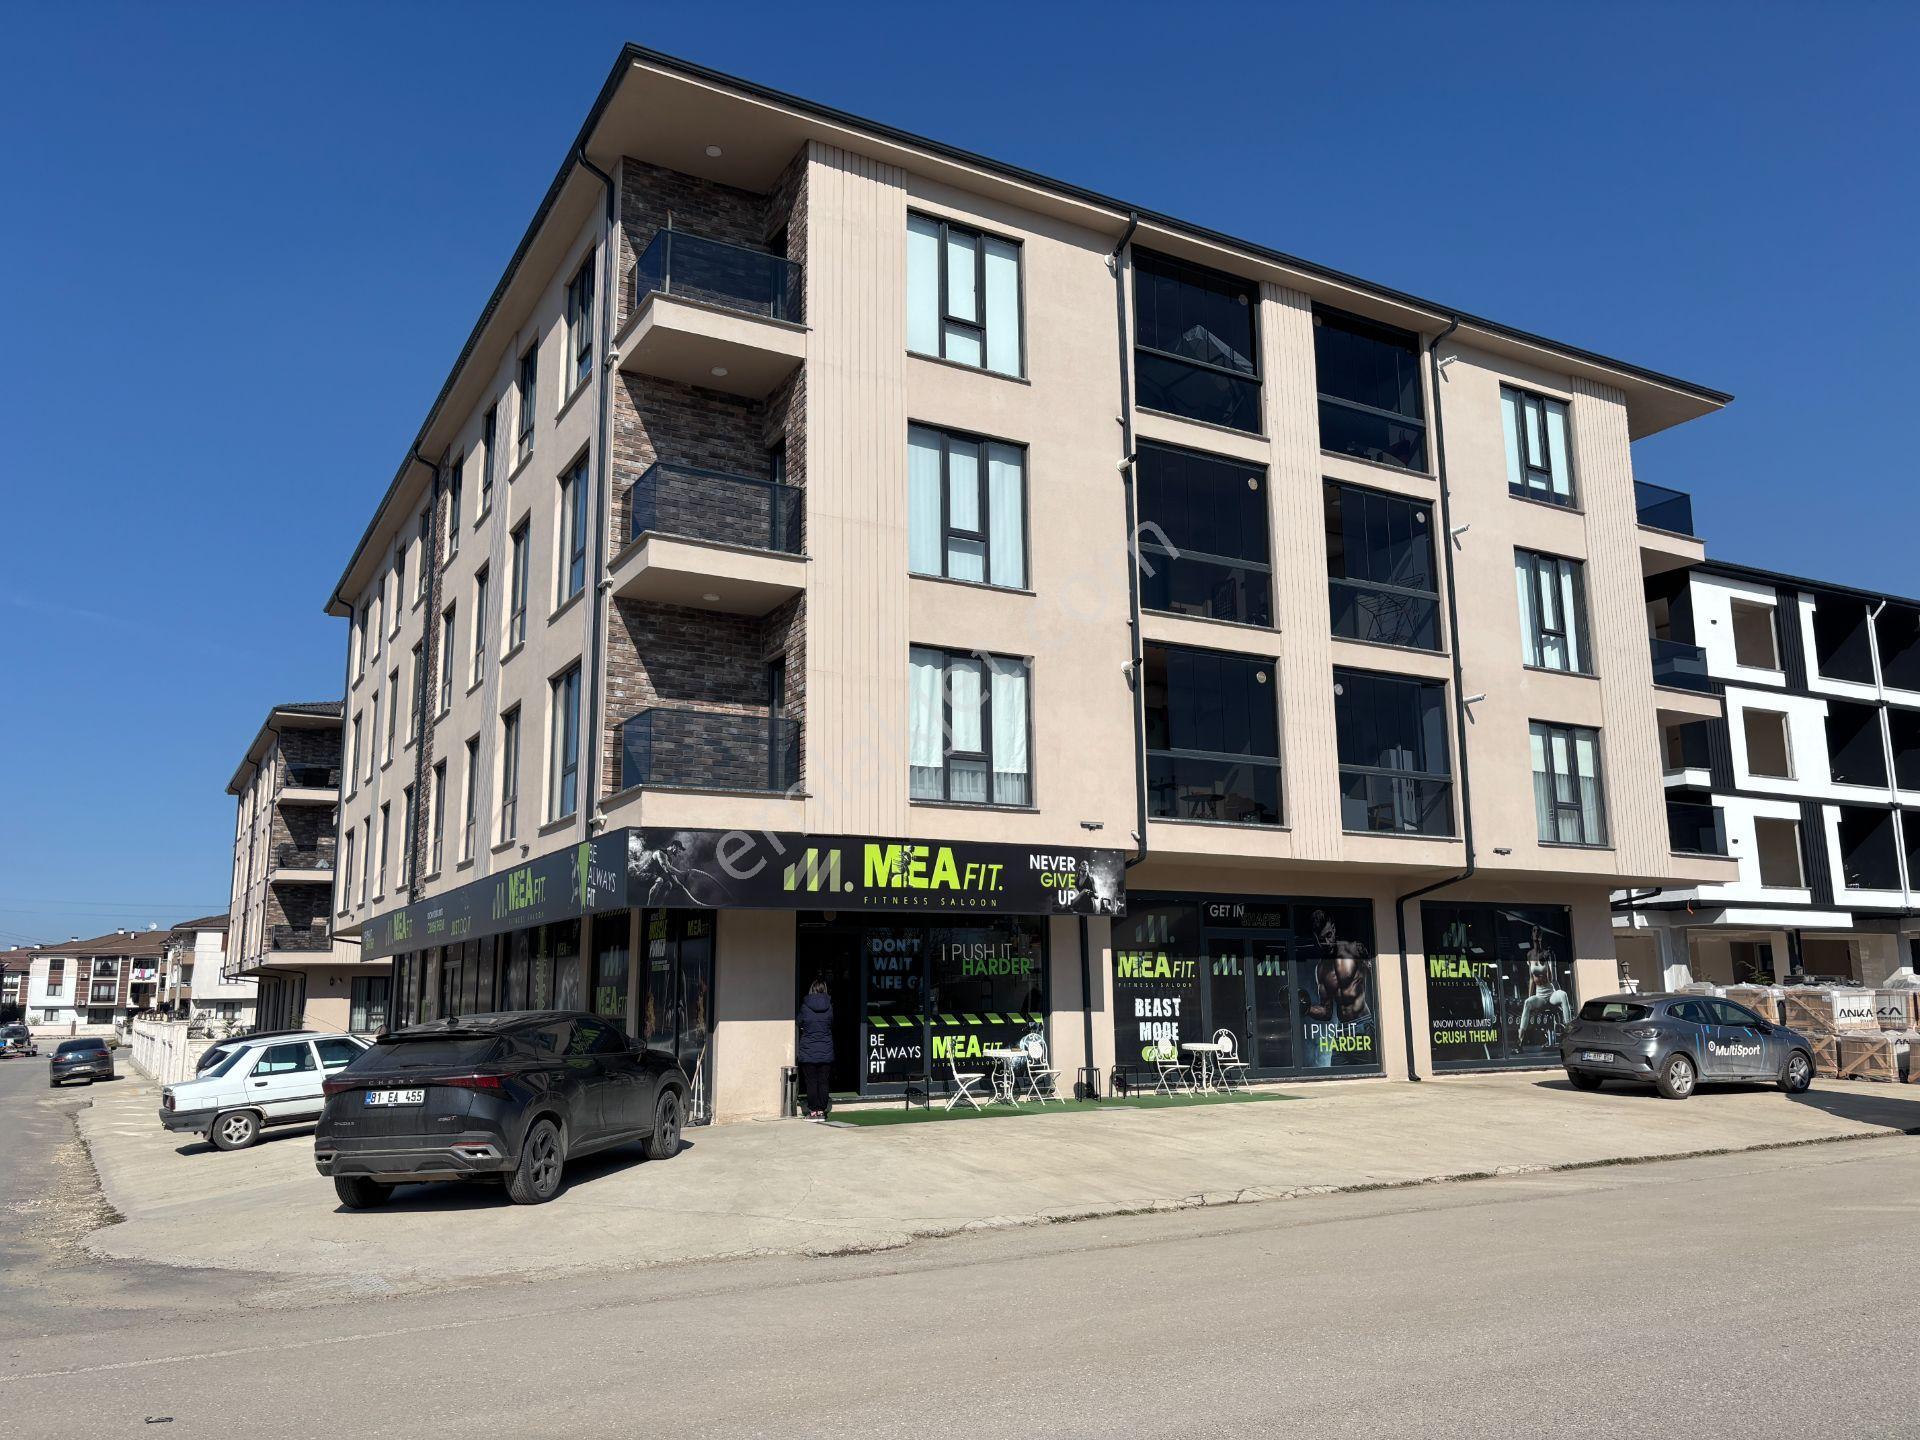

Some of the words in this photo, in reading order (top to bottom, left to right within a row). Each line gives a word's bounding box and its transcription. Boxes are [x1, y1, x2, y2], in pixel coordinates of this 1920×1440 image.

[863, 843, 961, 890] MEA
[1029, 854, 1076, 872] NEVER
[588, 866, 617, 893] ALWAYS
[1040, 872, 1076, 889] GIVE
[508, 867, 534, 911] MEA
[586, 886, 596, 908] FIT
[1058, 889, 1078, 906] UP
[864, 896, 928, 905] FITNESS
[940, 897, 998, 907] SALOON
[1209, 904, 1231, 917] GET
[1233, 904, 1245, 918] IN
[872, 938, 921, 952] DON'T
[942, 944, 947, 961] I
[952, 944, 995, 961] PUSH
[1001, 943, 1013, 960] IT
[874, 957, 912, 971] WAIT
[962, 958, 1031, 976] HARDER
[1117, 951, 1171, 978] MEA
[1429, 955, 1471, 978] MEA
[872, 975, 902, 990] LIFE
[1135, 997, 1181, 1017] BEAST
[1839, 1008, 1874, 1018] ANKA
[1139, 1022, 1180, 1041] MODE
[1311, 1023, 1344, 1040] PUSH
[1348, 1022, 1357, 1038] IT
[1433, 1019, 1454, 1029] KNOW
[1455, 1019, 1472, 1028] YOUR
[1474, 1018, 1492, 1028] LIMITS
[869, 1033, 885, 1047] BE
[1319, 1035, 1371, 1053] HARDER
[1434, 1031, 1467, 1045] CRUSH
[1469, 1029, 1499, 1043] THEM!
[869, 1046, 921, 1061] ALWAYS
[932, 1034, 982, 1059] MEA
[1714, 1043, 1761, 1057] MultiSport
[869, 1061, 886, 1074] FIT
[370, 1092, 382, 1104] 81
[387, 1092, 399, 1103] EA
[405, 1091, 423, 1103] 455
